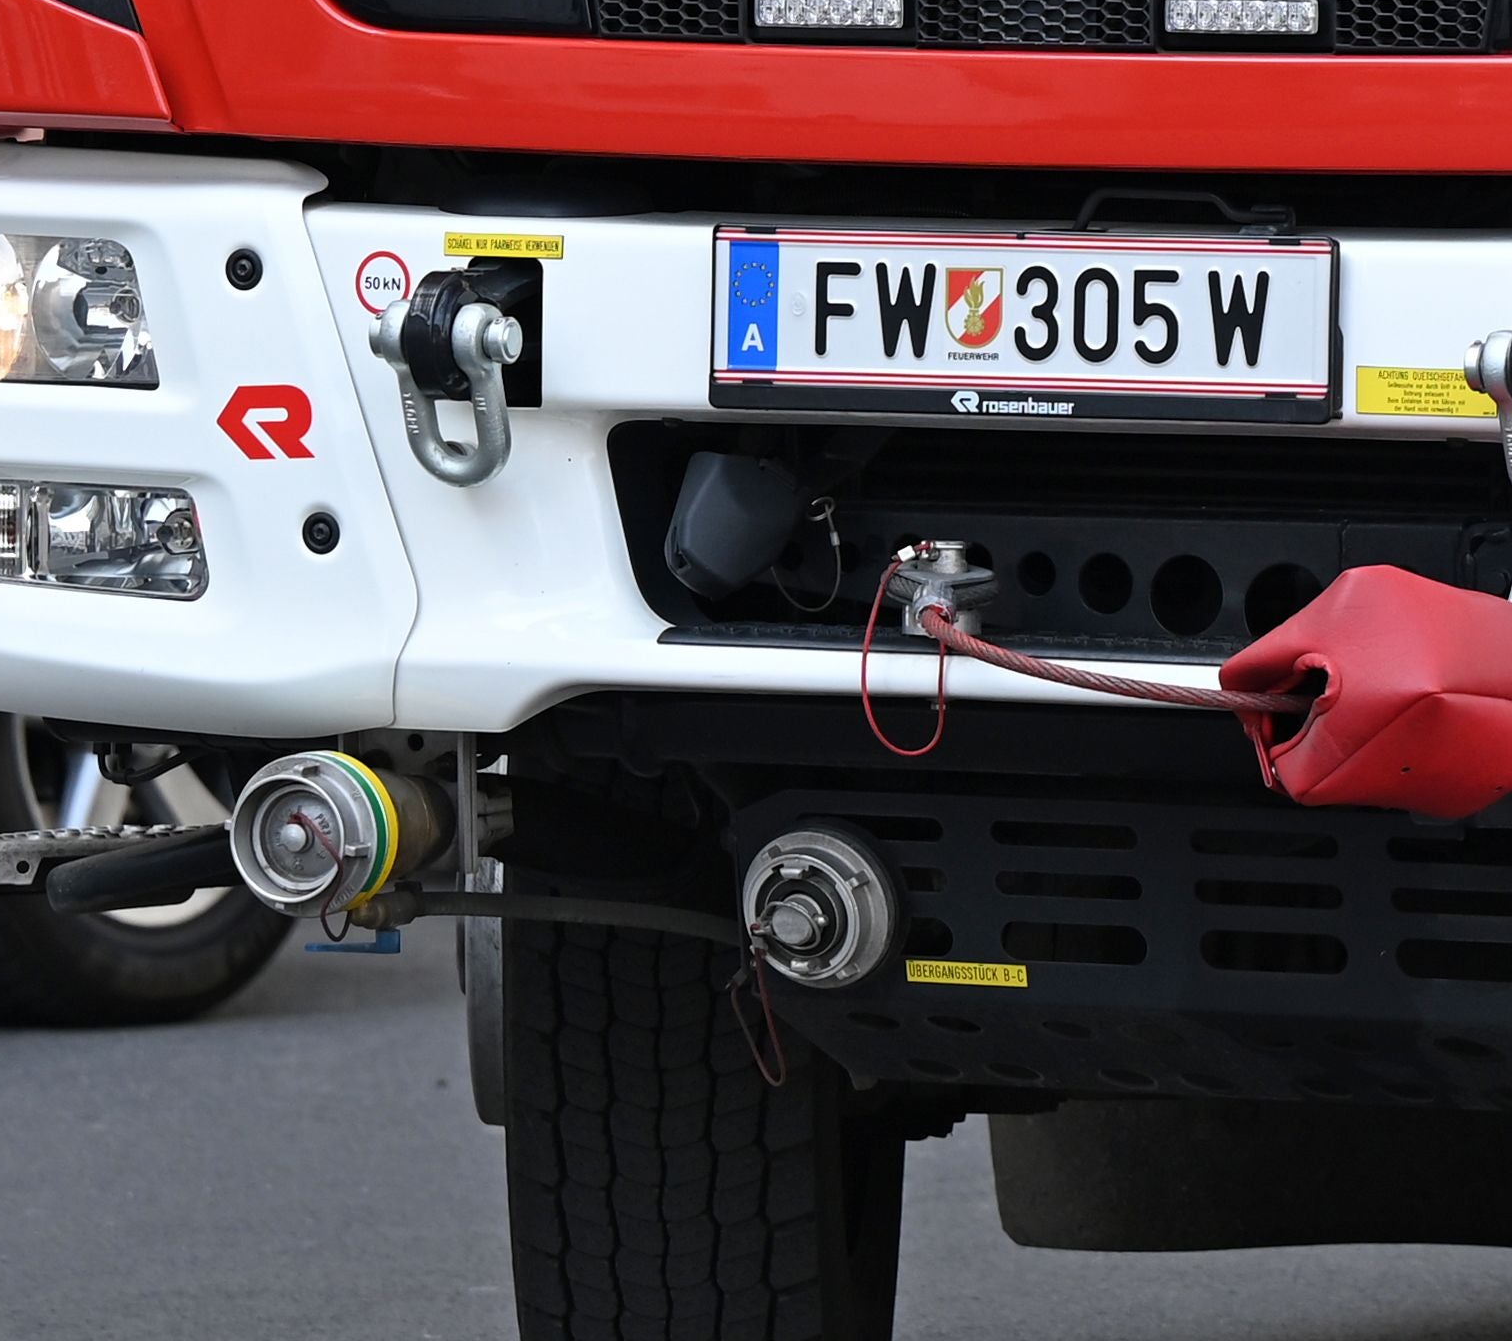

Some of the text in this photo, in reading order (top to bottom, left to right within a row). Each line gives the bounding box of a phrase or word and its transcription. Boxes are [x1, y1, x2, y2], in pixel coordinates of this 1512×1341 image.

[364, 276, 401, 291] 50 kN
[814, 260, 1270, 368] FW 305 W
[741, 322, 764, 352] A
[948, 352, 999, 361] FEUERWEHR
[982, 397, 1075, 415] rosenbauer
[908, 959, 1024, 983] ÜBERGANGSSTÜCK B-C
